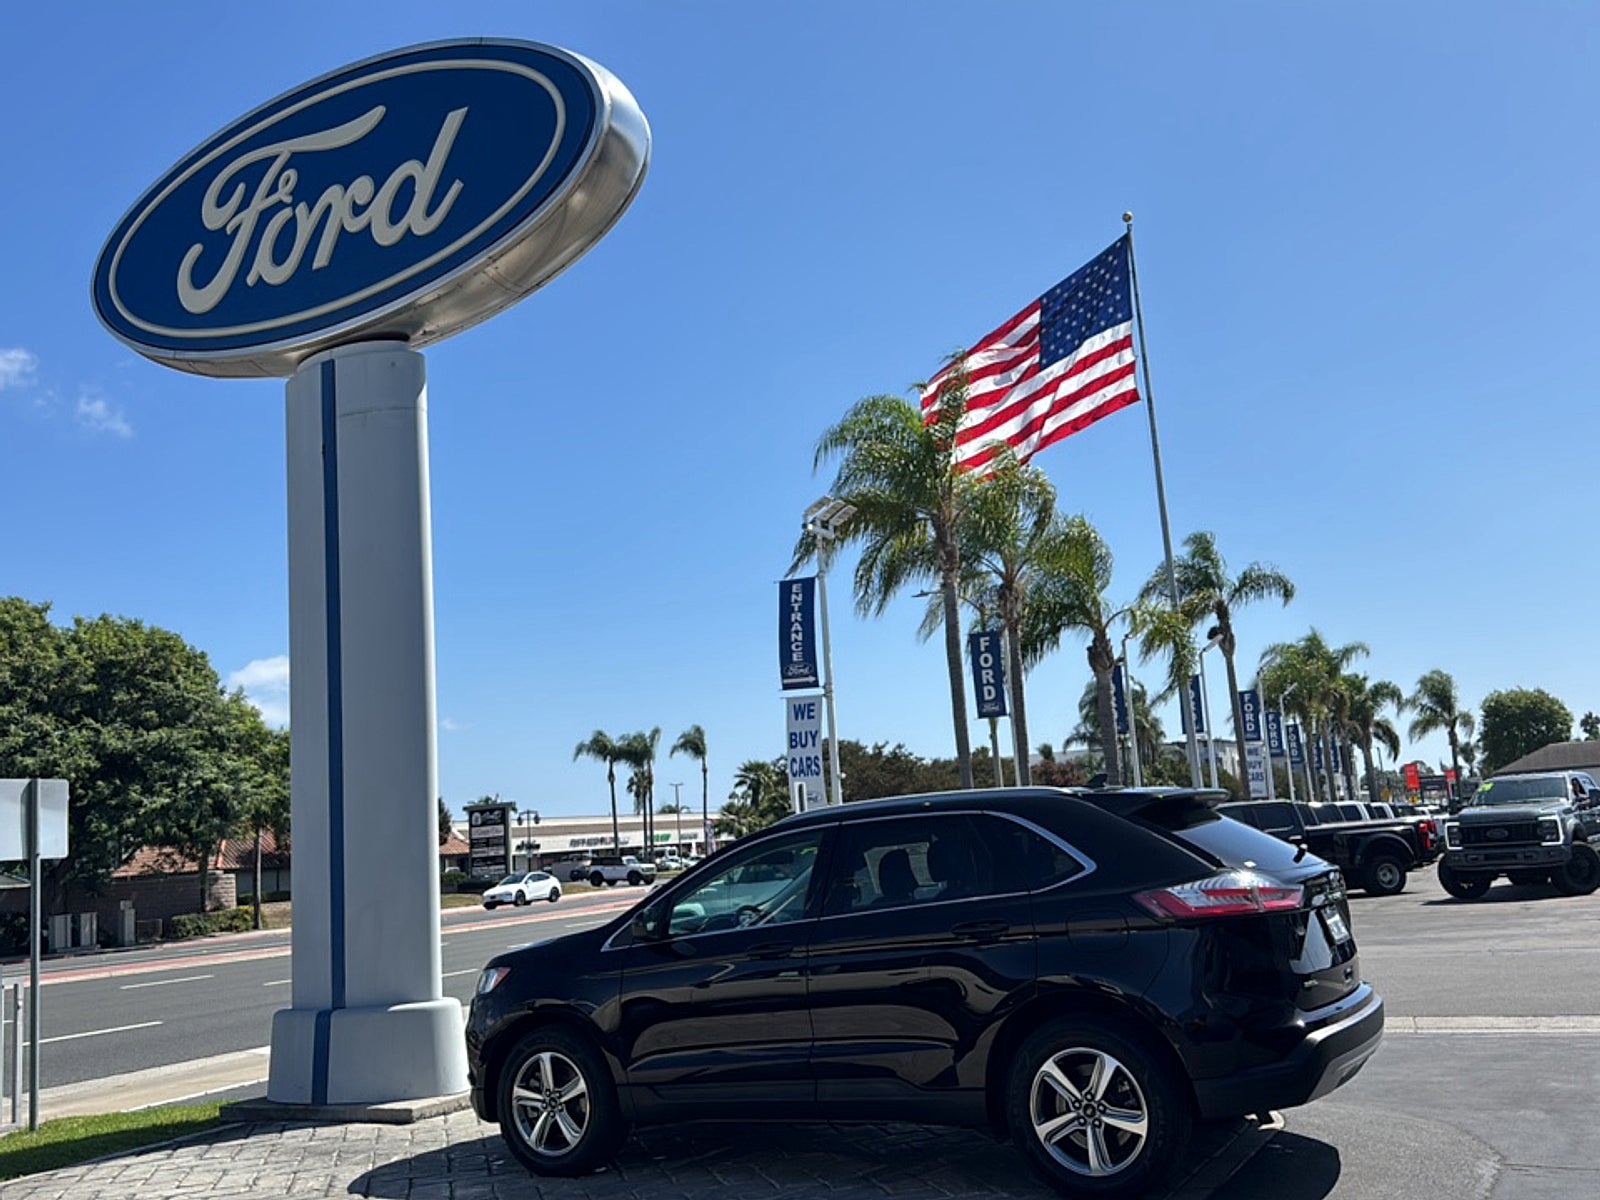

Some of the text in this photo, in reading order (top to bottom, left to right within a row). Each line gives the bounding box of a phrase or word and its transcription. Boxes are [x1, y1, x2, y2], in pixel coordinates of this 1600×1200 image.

[177, 104, 469, 314] Ford
[790, 583, 804, 662] ENTRANCE
[979, 636, 996, 702] FORD
[793, 702, 816, 721] WE
[1243, 693, 1255, 732] FORD
[789, 730, 818, 750] BUY
[1268, 713, 1279, 748] FORD
[790, 755, 821, 778] CARS
